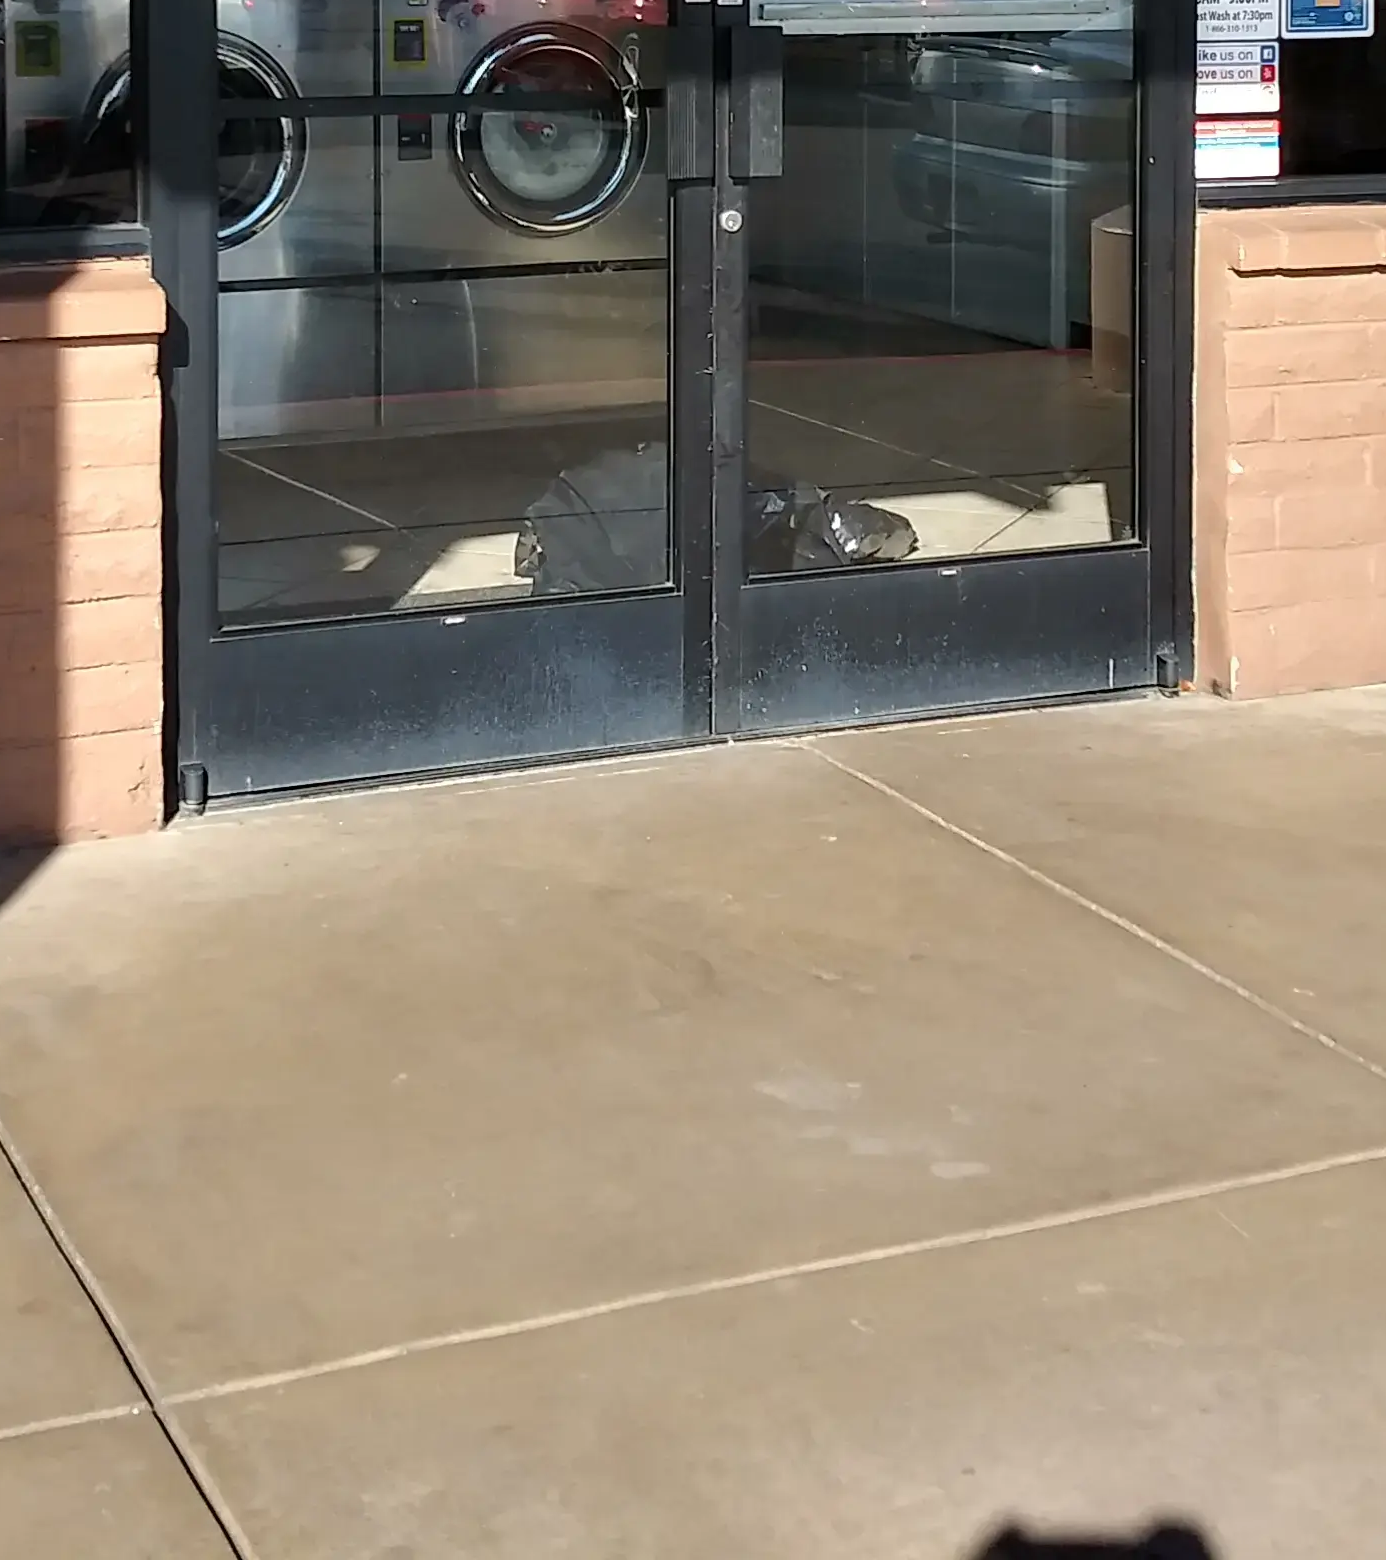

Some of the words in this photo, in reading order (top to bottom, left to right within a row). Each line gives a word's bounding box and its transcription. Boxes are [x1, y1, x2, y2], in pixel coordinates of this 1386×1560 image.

[1208, 11, 1229, 21] Wash
[1232, 11, 1241, 20] at
[1242, 10, 1274, 22] 7:30pm
[1198, 49, 1217, 61] ike
[1219, 51, 1234, 61] us
[1237, 51, 1254, 61] on
[1197, 69, 1217, 80] ove
[1220, 69, 1234, 80] us
[1237, 69, 1254, 80] on
